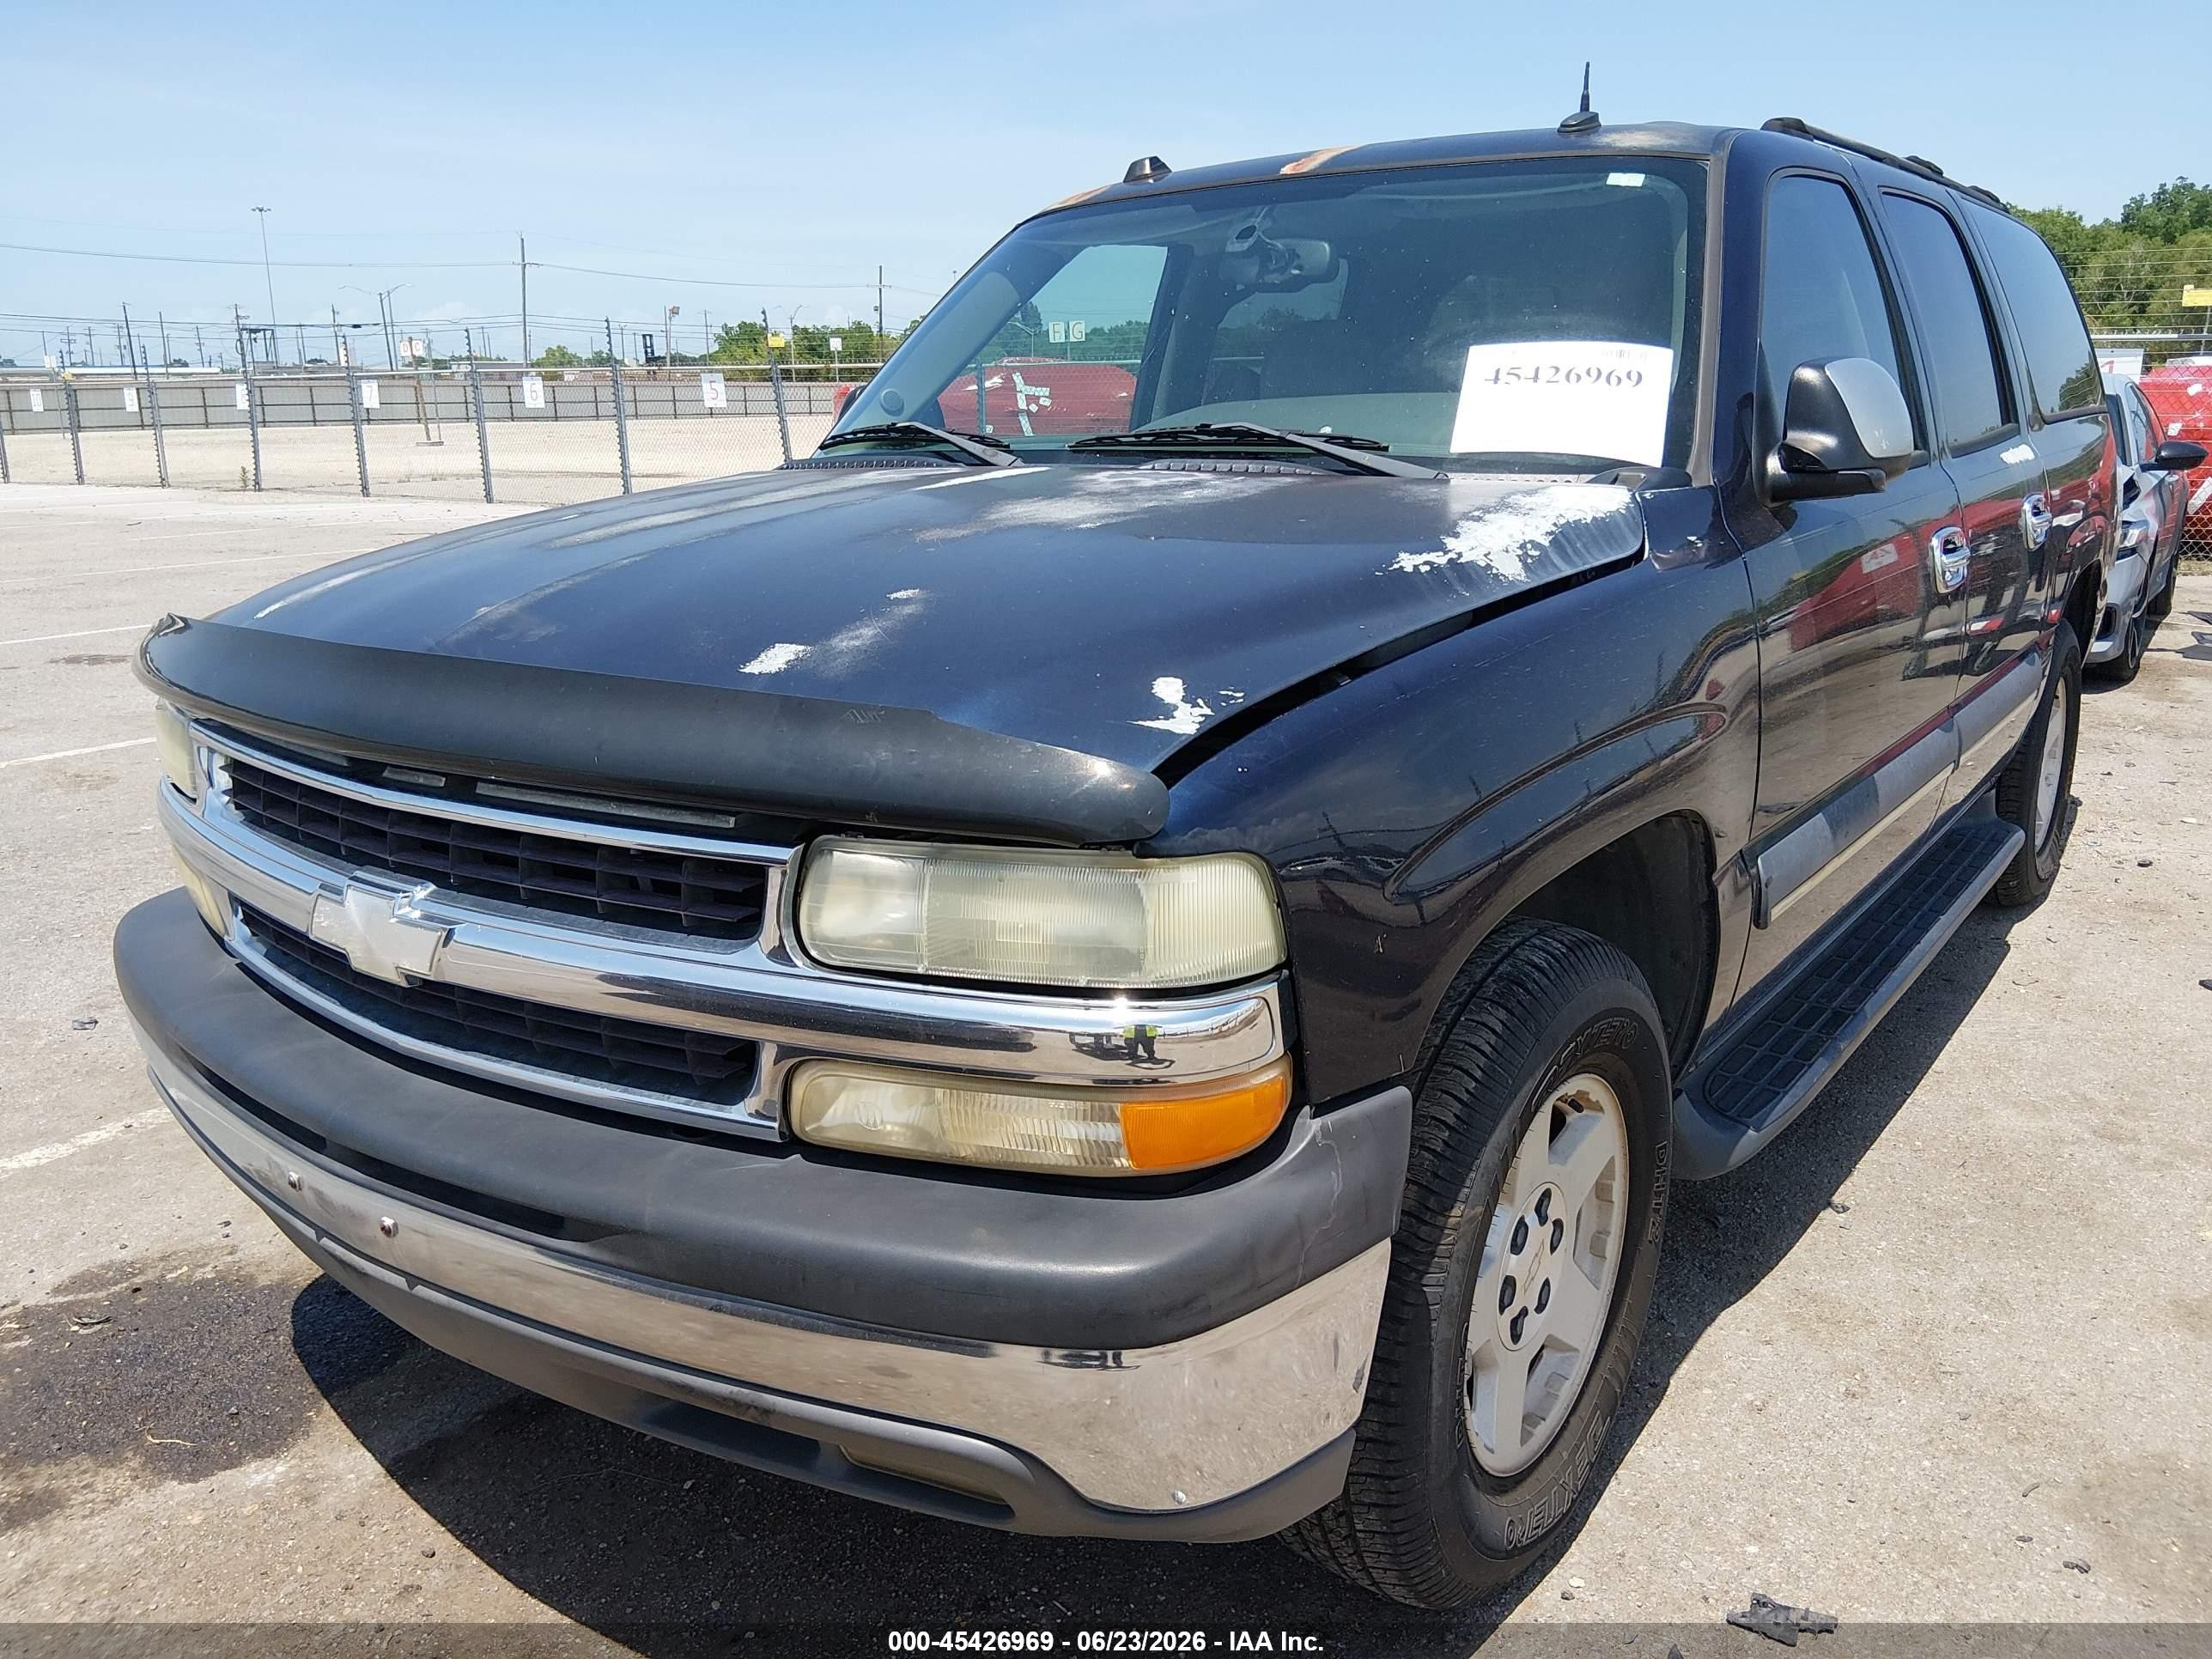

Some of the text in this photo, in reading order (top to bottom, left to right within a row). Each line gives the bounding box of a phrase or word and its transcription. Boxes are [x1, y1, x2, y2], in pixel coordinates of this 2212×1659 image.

[1052, 321, 1084, 342] F G
[1484, 365, 1644, 387] 45426969
[366, 386, 374, 401] 7
[529, 383, 538, 401] 6
[708, 380, 719, 400] 5
